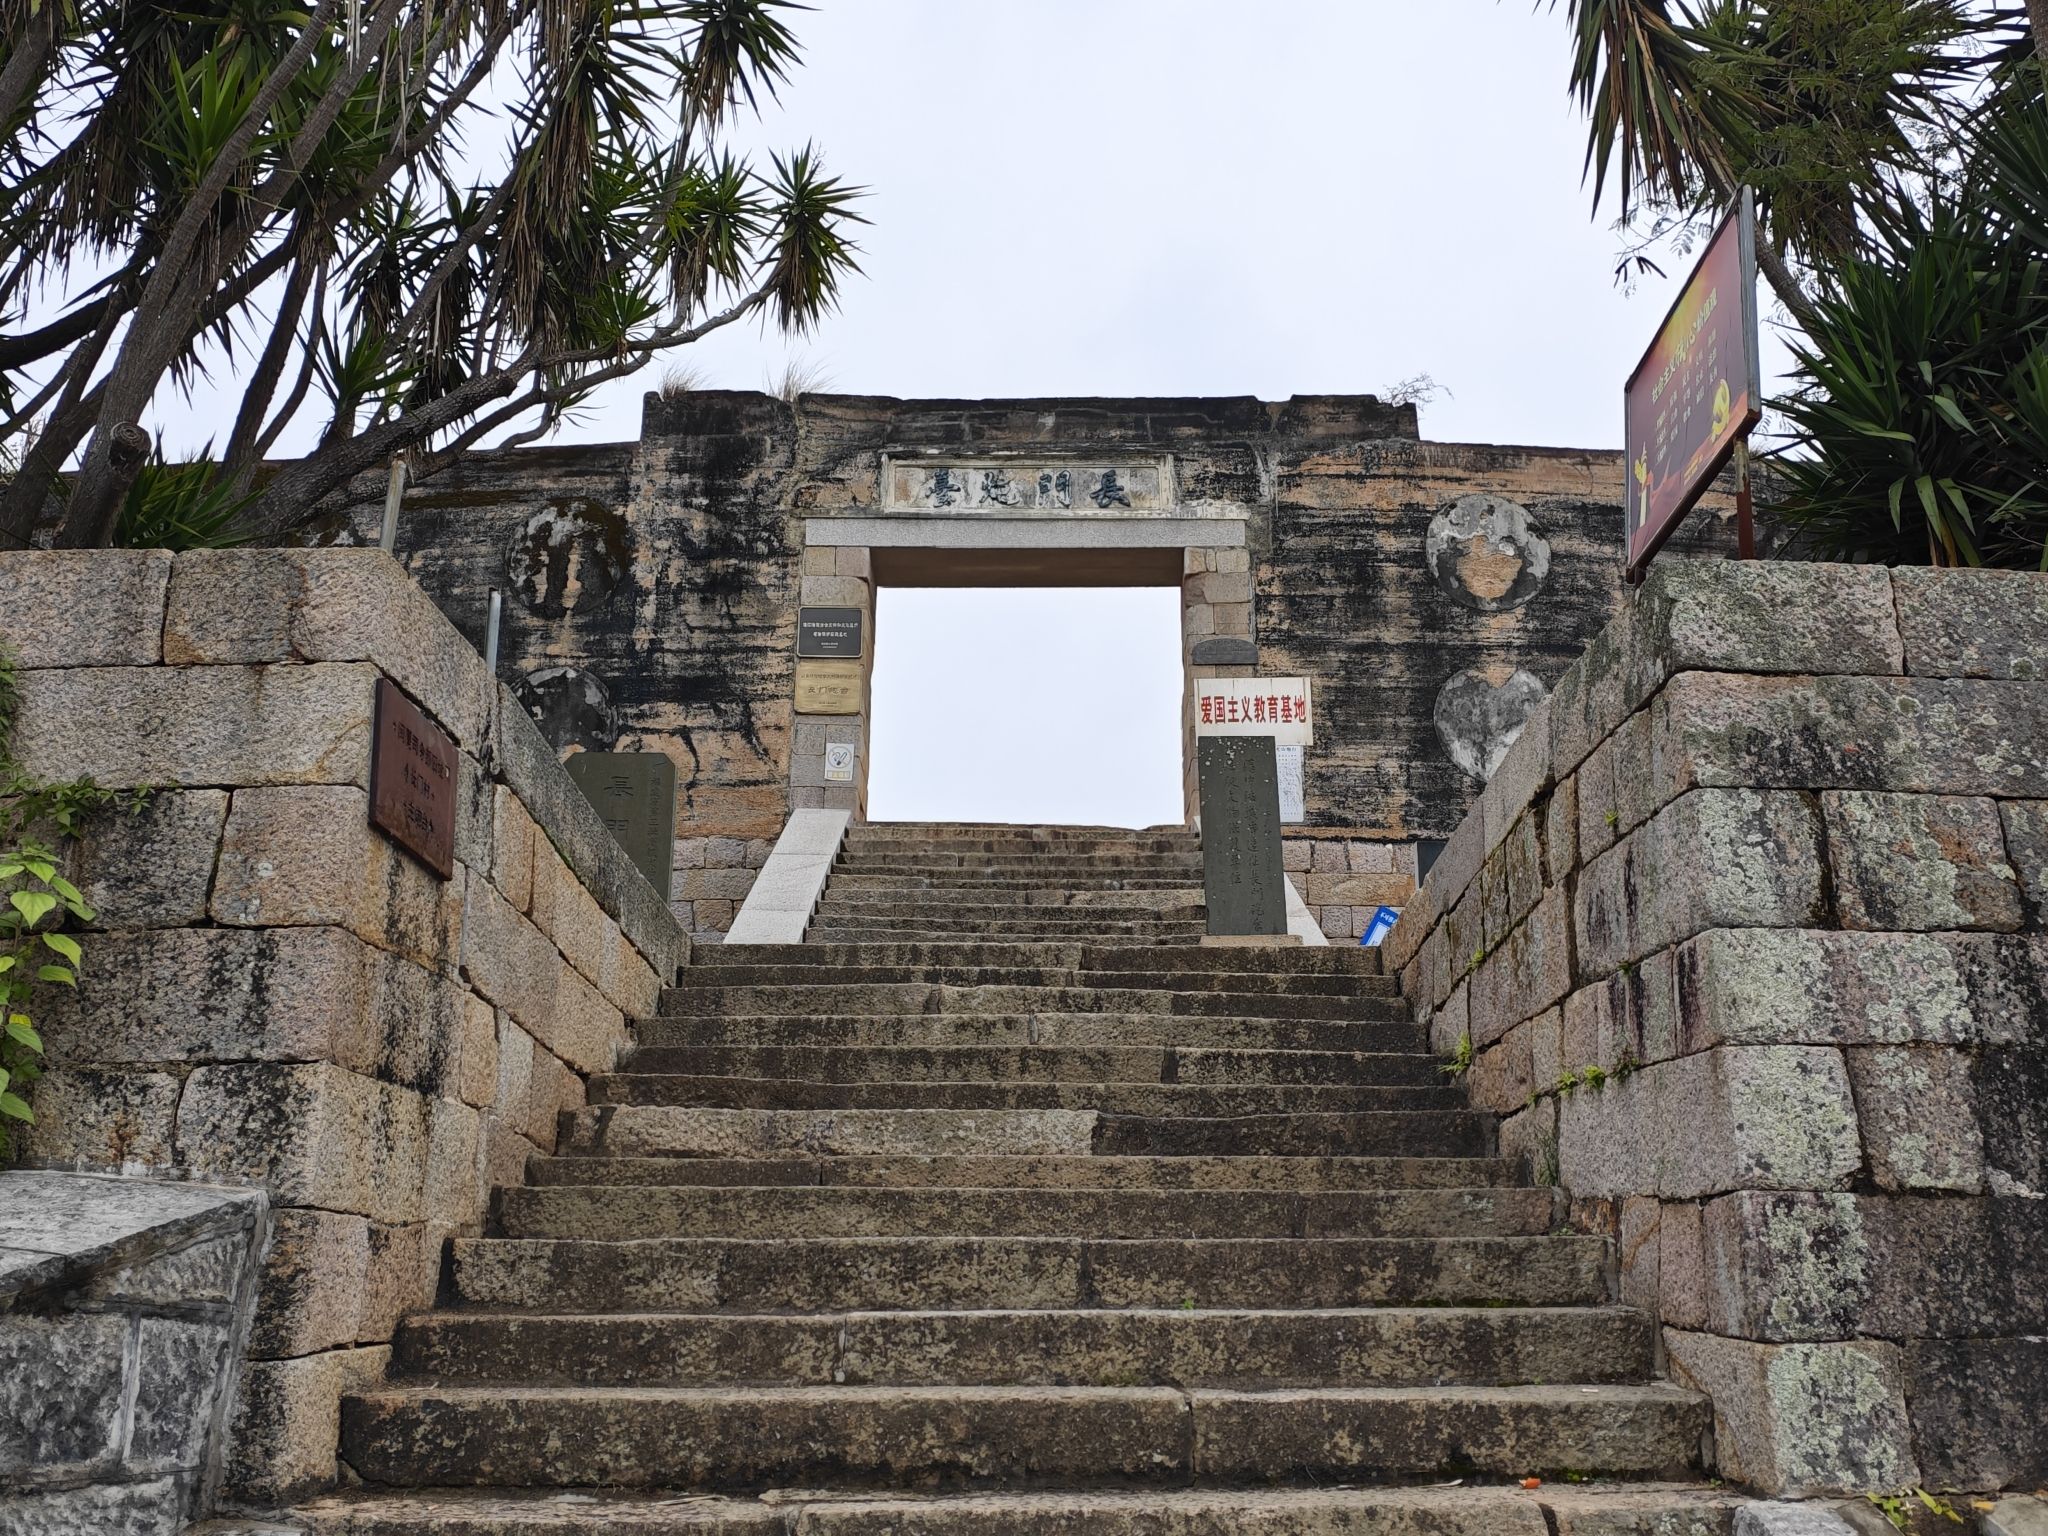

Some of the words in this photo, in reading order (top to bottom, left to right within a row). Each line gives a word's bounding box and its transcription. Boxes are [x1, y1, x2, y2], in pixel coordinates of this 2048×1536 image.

[1200, 694, 1307, 724] 爱国主义教育基地
